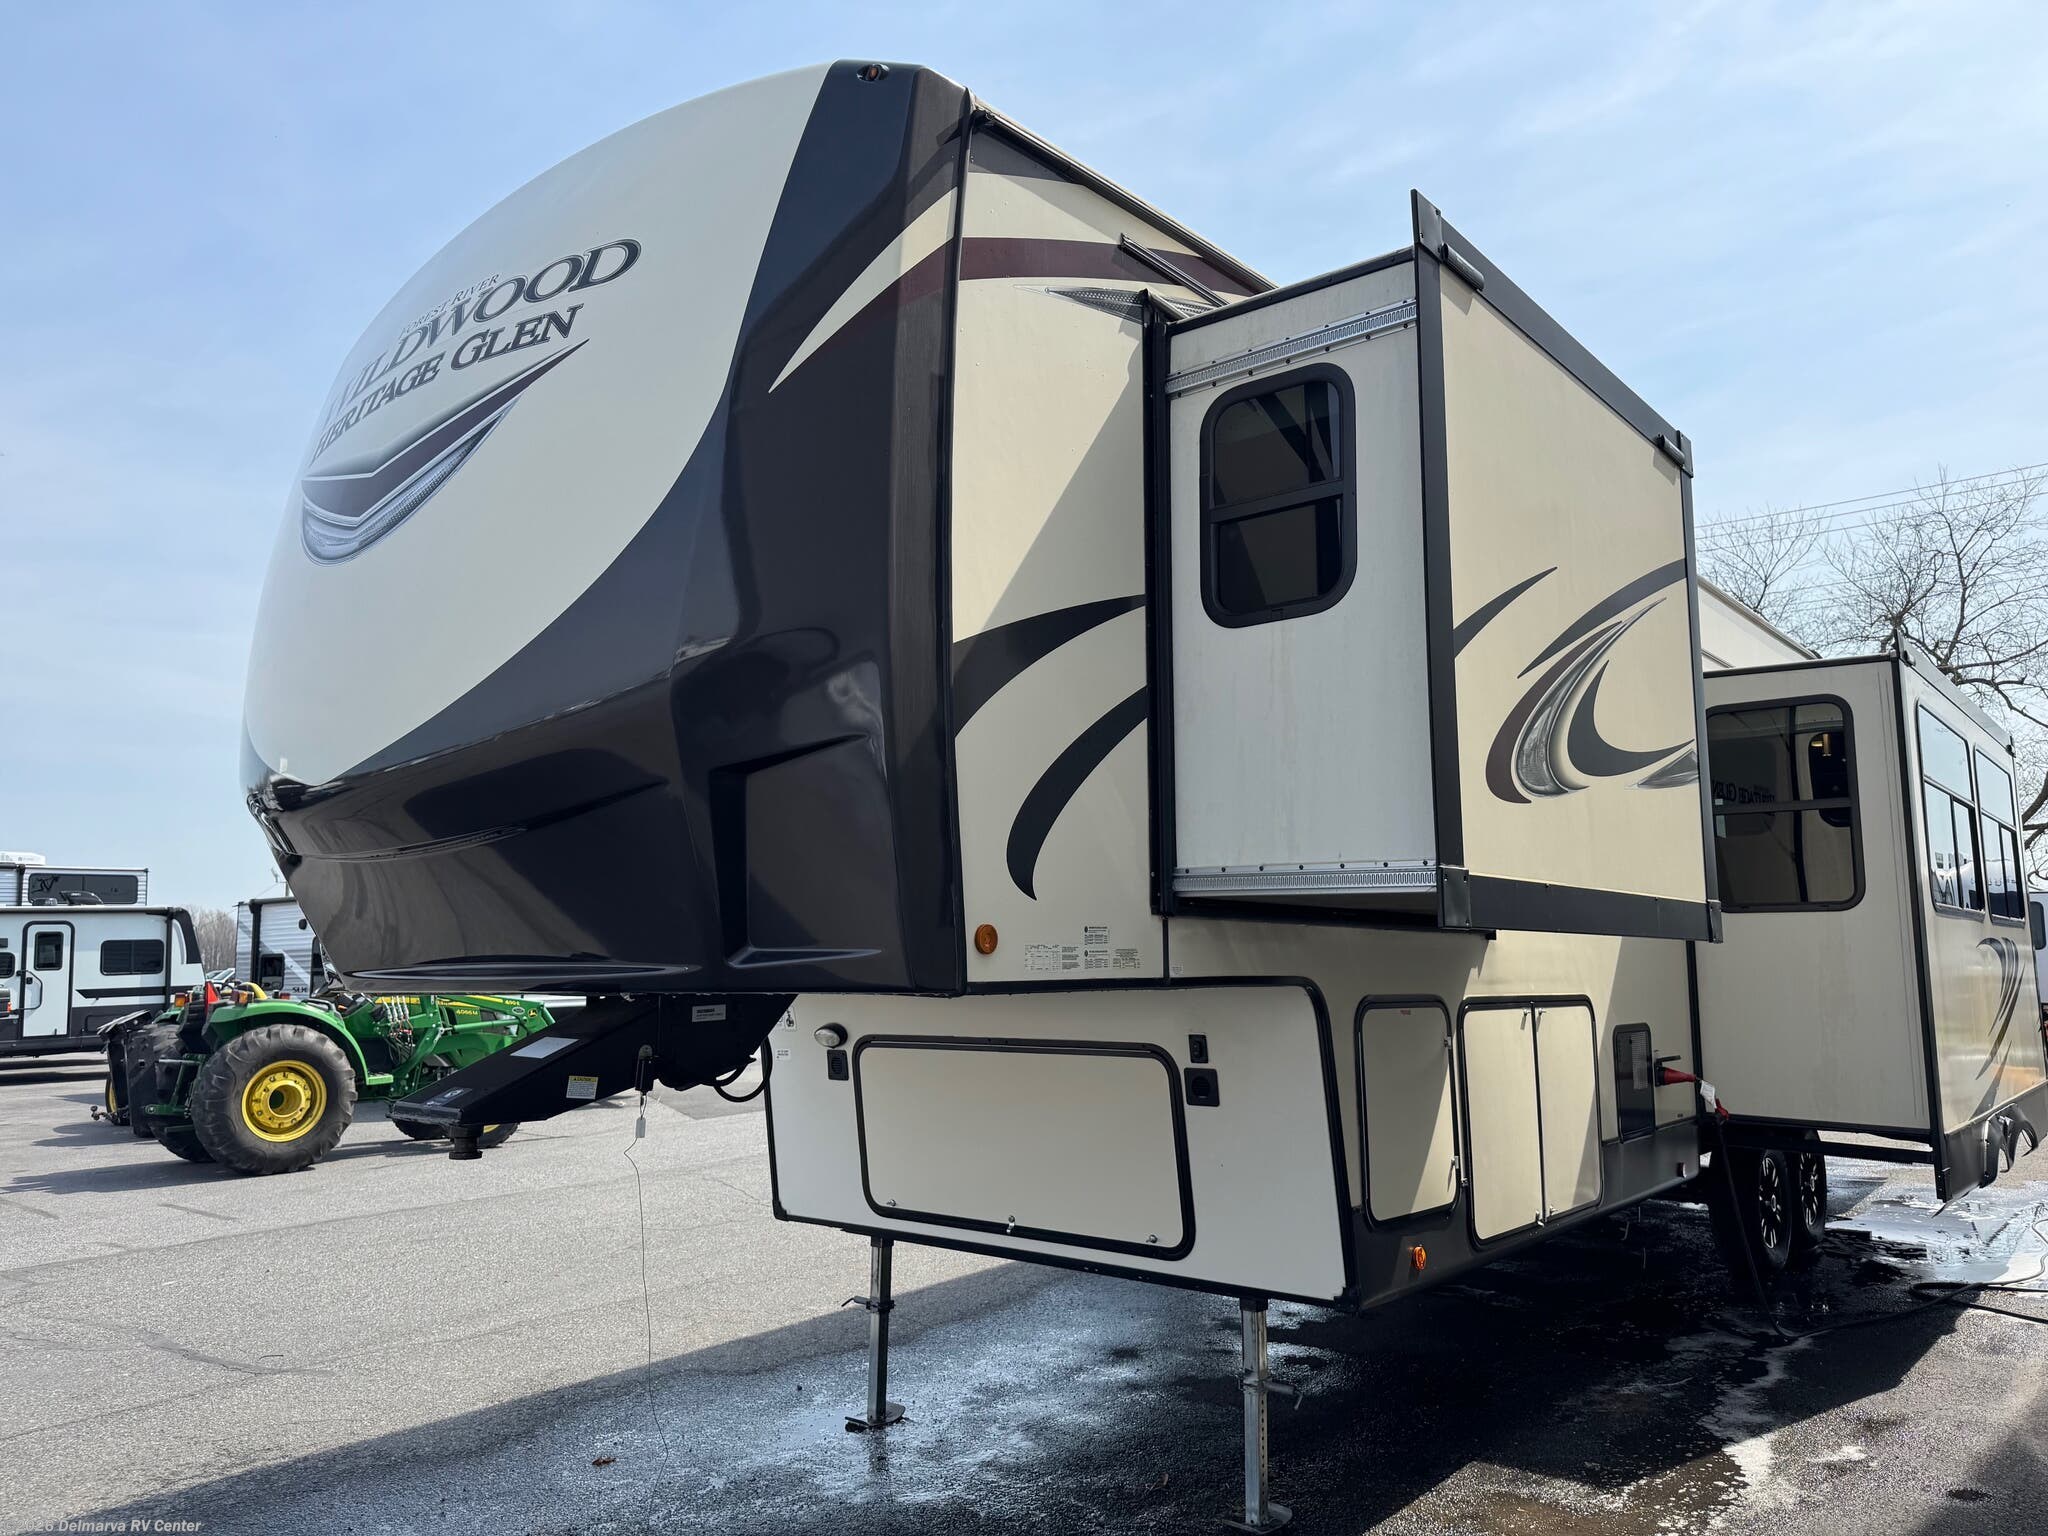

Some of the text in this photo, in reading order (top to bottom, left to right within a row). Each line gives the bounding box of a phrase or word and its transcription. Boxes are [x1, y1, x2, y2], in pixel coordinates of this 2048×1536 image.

[323, 238, 642, 430] WILDWOOD
[452, 274, 500, 304] RIVER
[309, 303, 584, 469] HERITAGE GLEN
